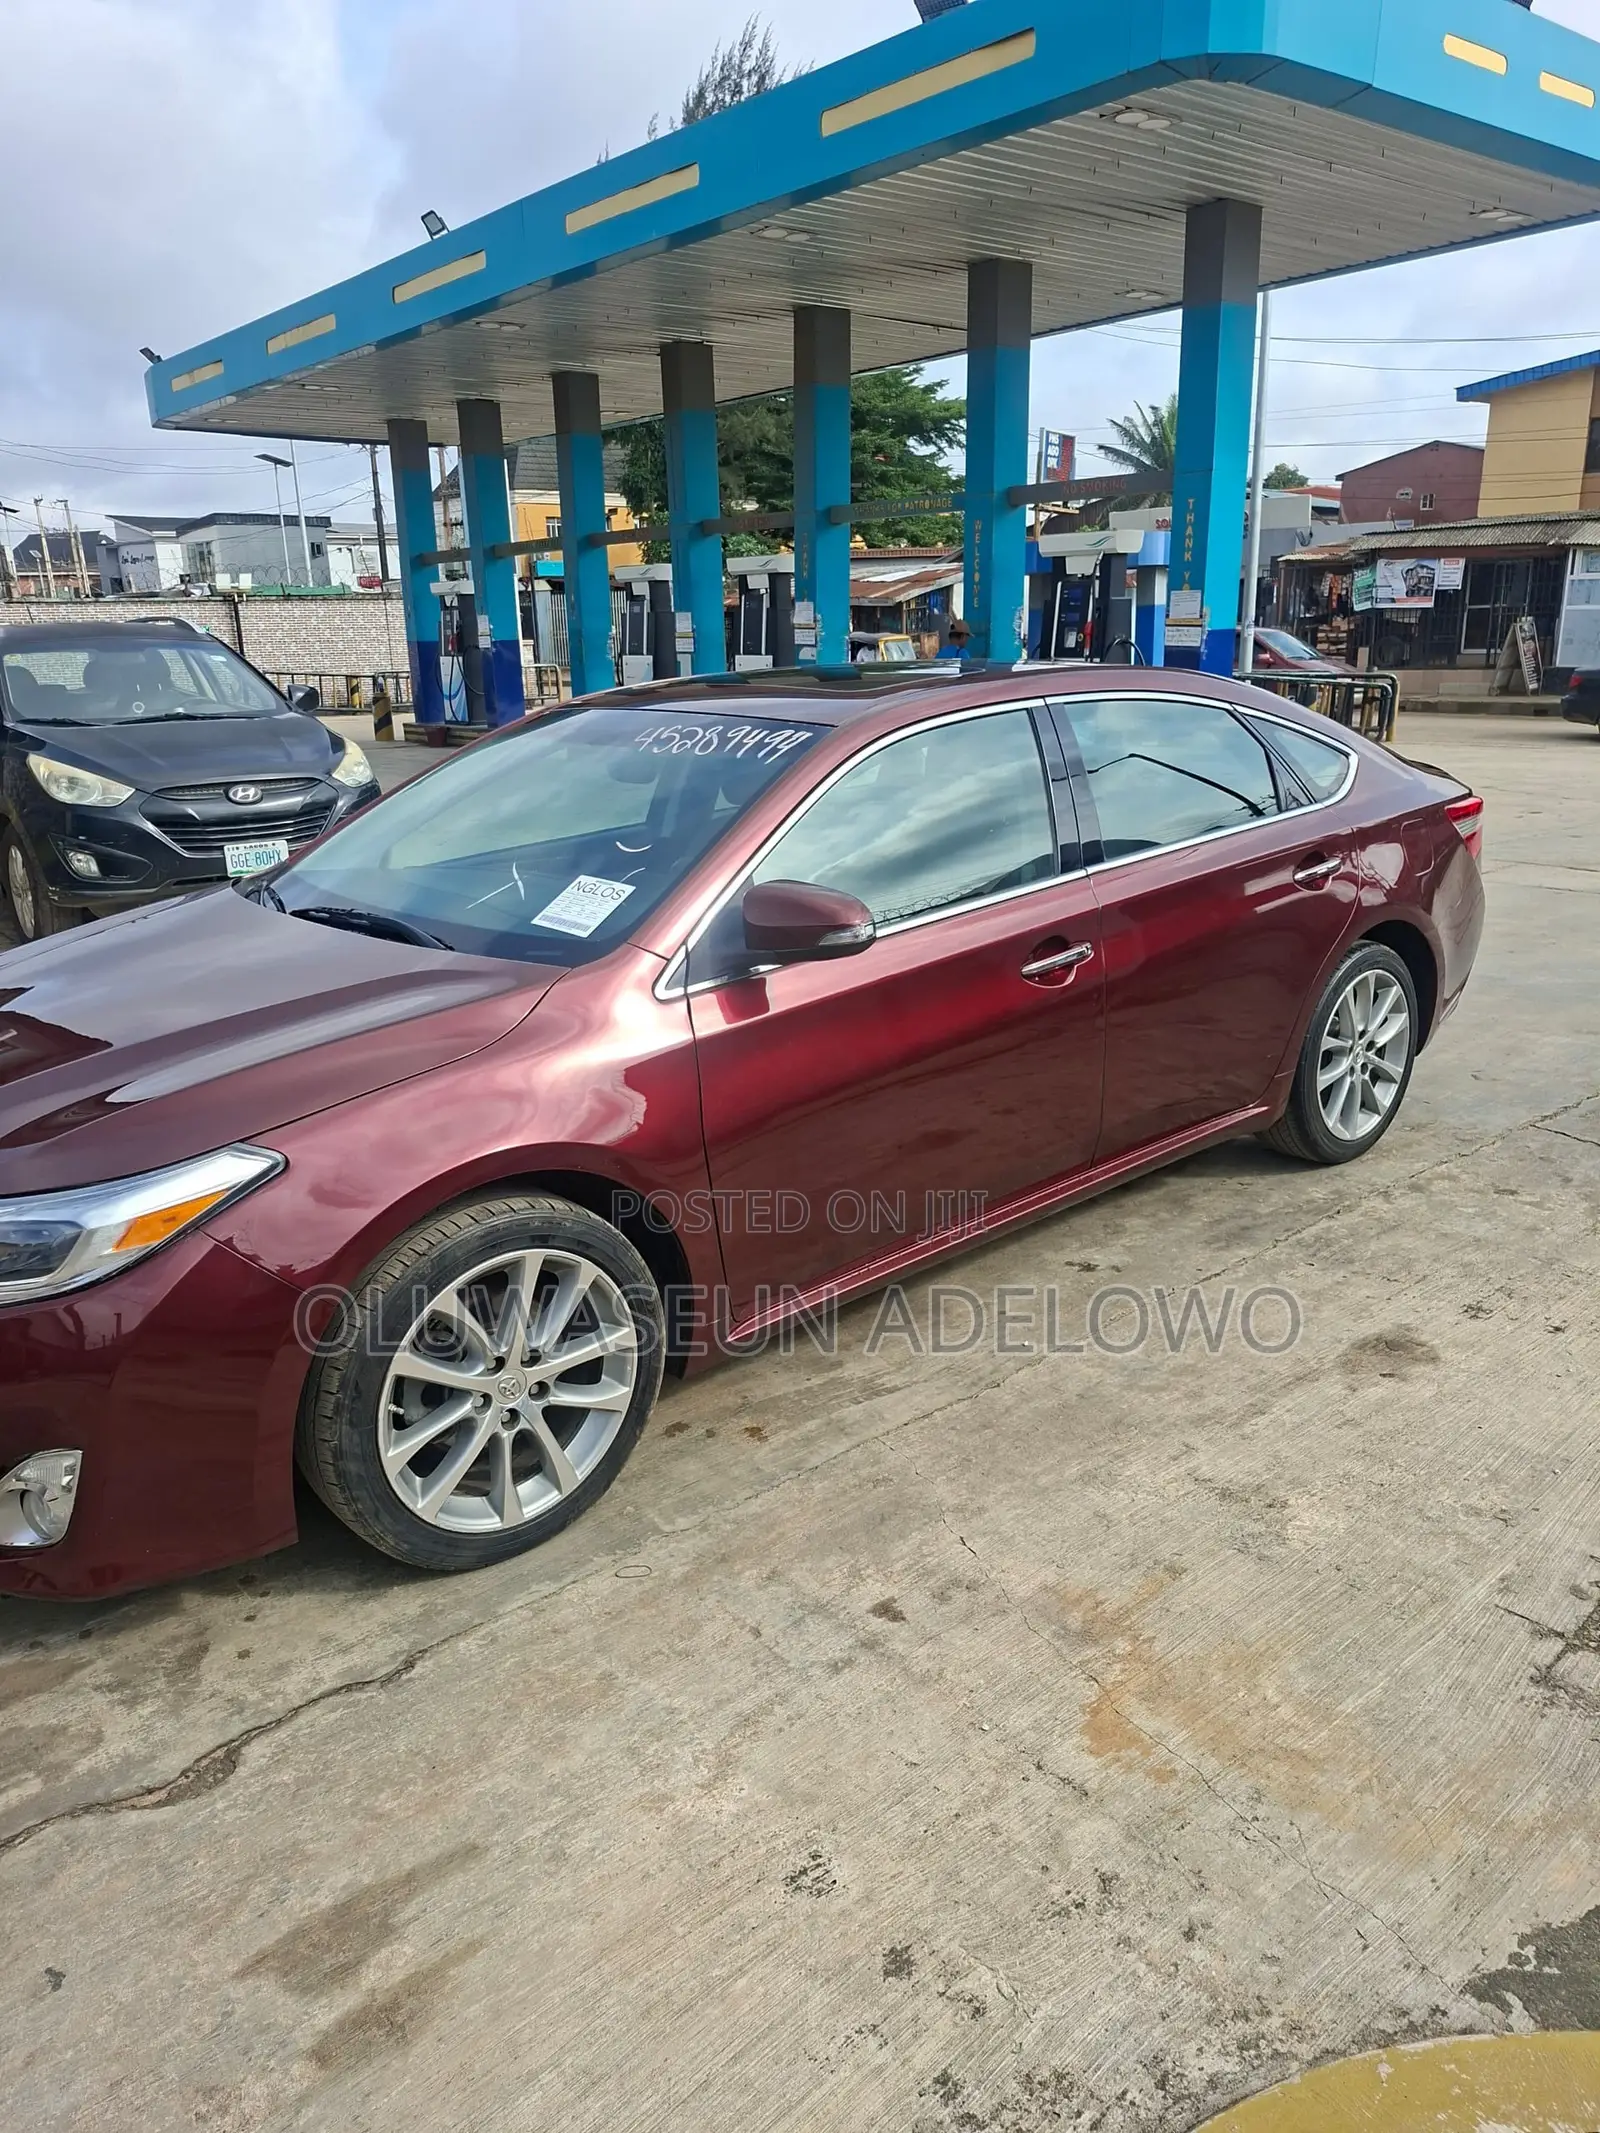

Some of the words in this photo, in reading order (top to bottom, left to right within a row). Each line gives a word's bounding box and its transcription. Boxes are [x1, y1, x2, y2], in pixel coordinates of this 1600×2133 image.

[1063, 482, 1077, 494] NO
[1080, 478, 1127, 494] SMOKING
[904, 497, 953, 512] PATRONAGE
[1183, 499, 1196, 562] THANK
[973, 519, 982, 608] WELCOME
[571, 880, 626, 901] NGLOS
